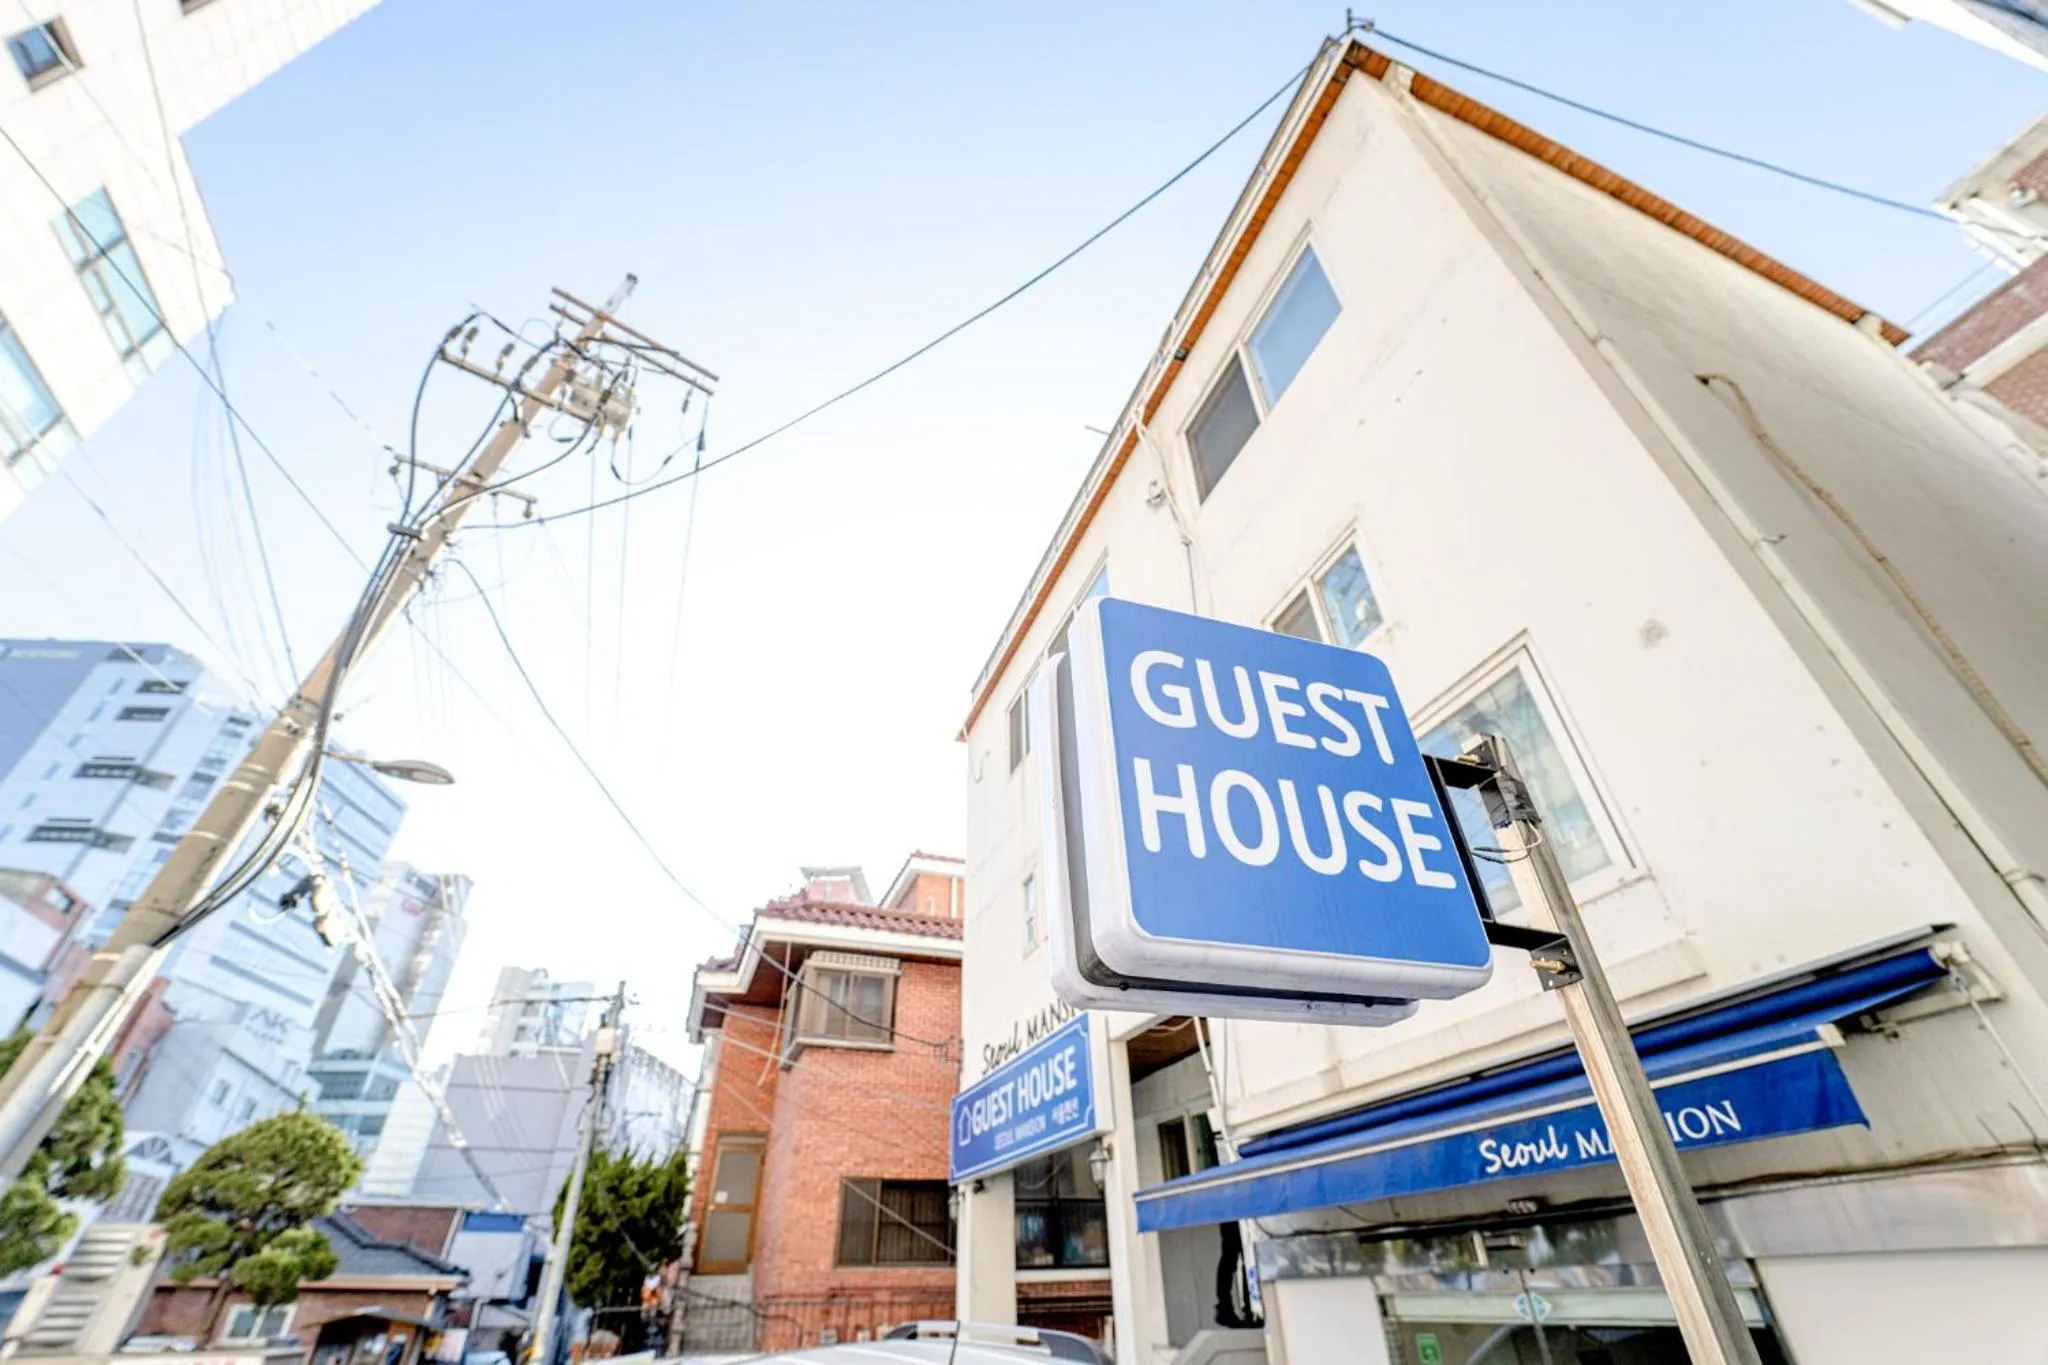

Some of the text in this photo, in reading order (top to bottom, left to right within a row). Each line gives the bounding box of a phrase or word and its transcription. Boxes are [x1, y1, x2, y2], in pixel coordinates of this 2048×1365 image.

[1130, 650, 1394, 765] GUEST
[1133, 757, 1457, 889] HOUSE
[971, 1080, 1015, 1136] GUEST
[1017, 1045, 1078, 1114] HOUSE
[1479, 1100, 1742, 1174] Seoul MION
